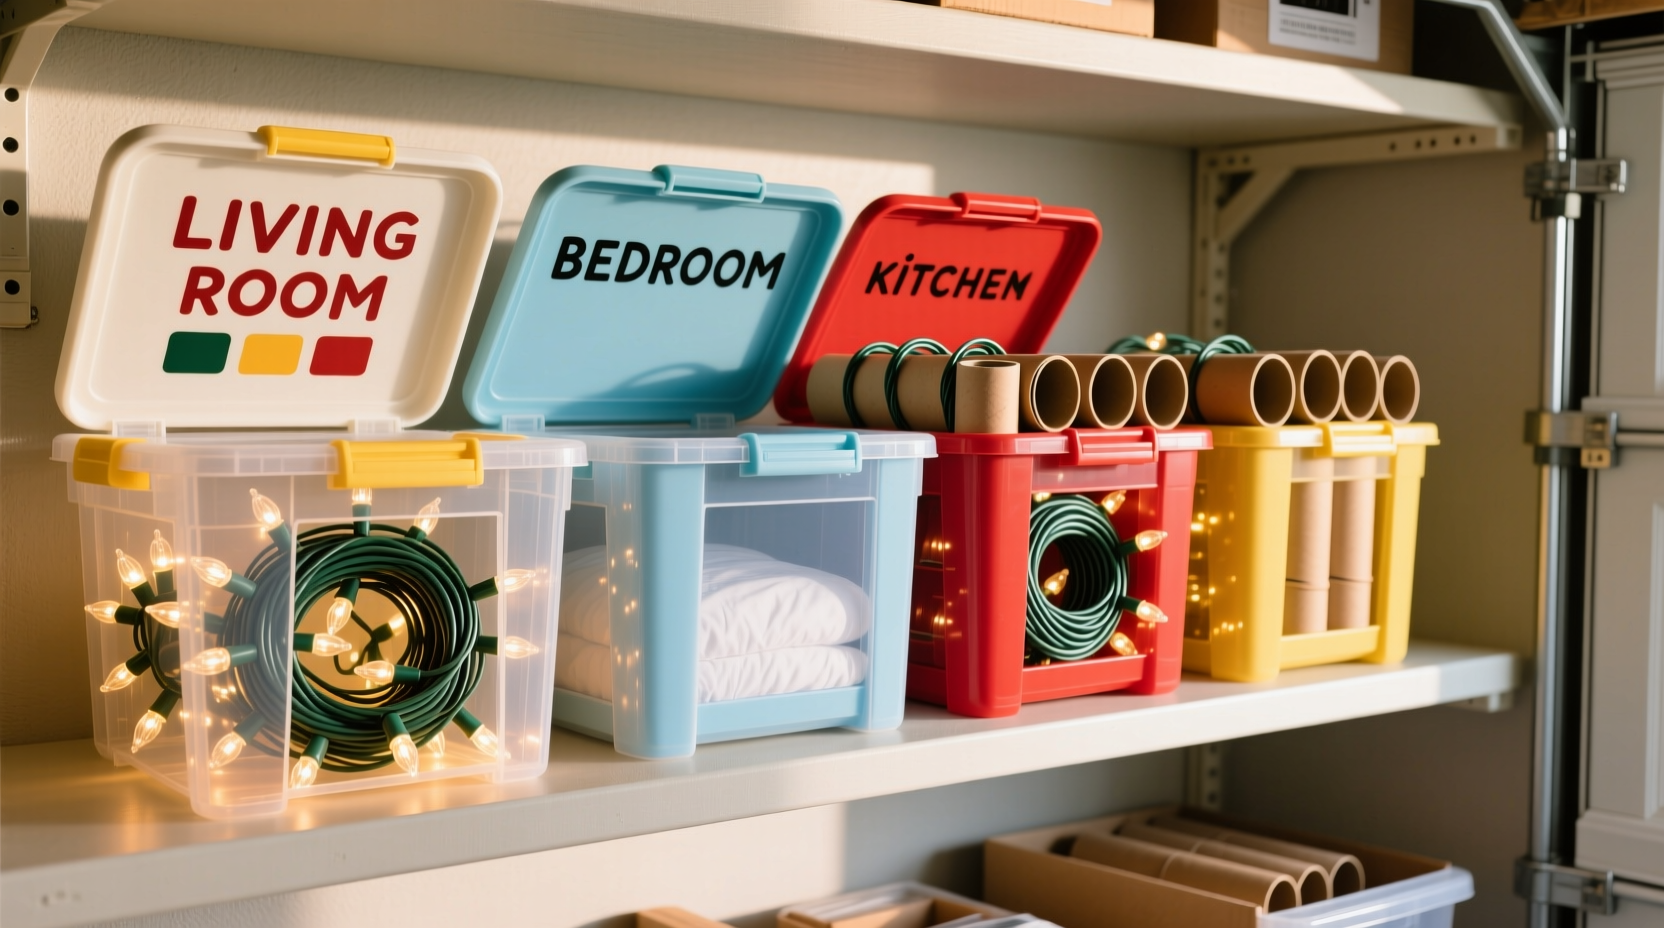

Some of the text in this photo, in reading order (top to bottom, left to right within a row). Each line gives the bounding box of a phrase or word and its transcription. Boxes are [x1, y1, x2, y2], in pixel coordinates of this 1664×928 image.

[172, 195, 420, 261] LIVING
[551, 236, 787, 292] BEDROOM
[179, 266, 389, 322] ROOM
